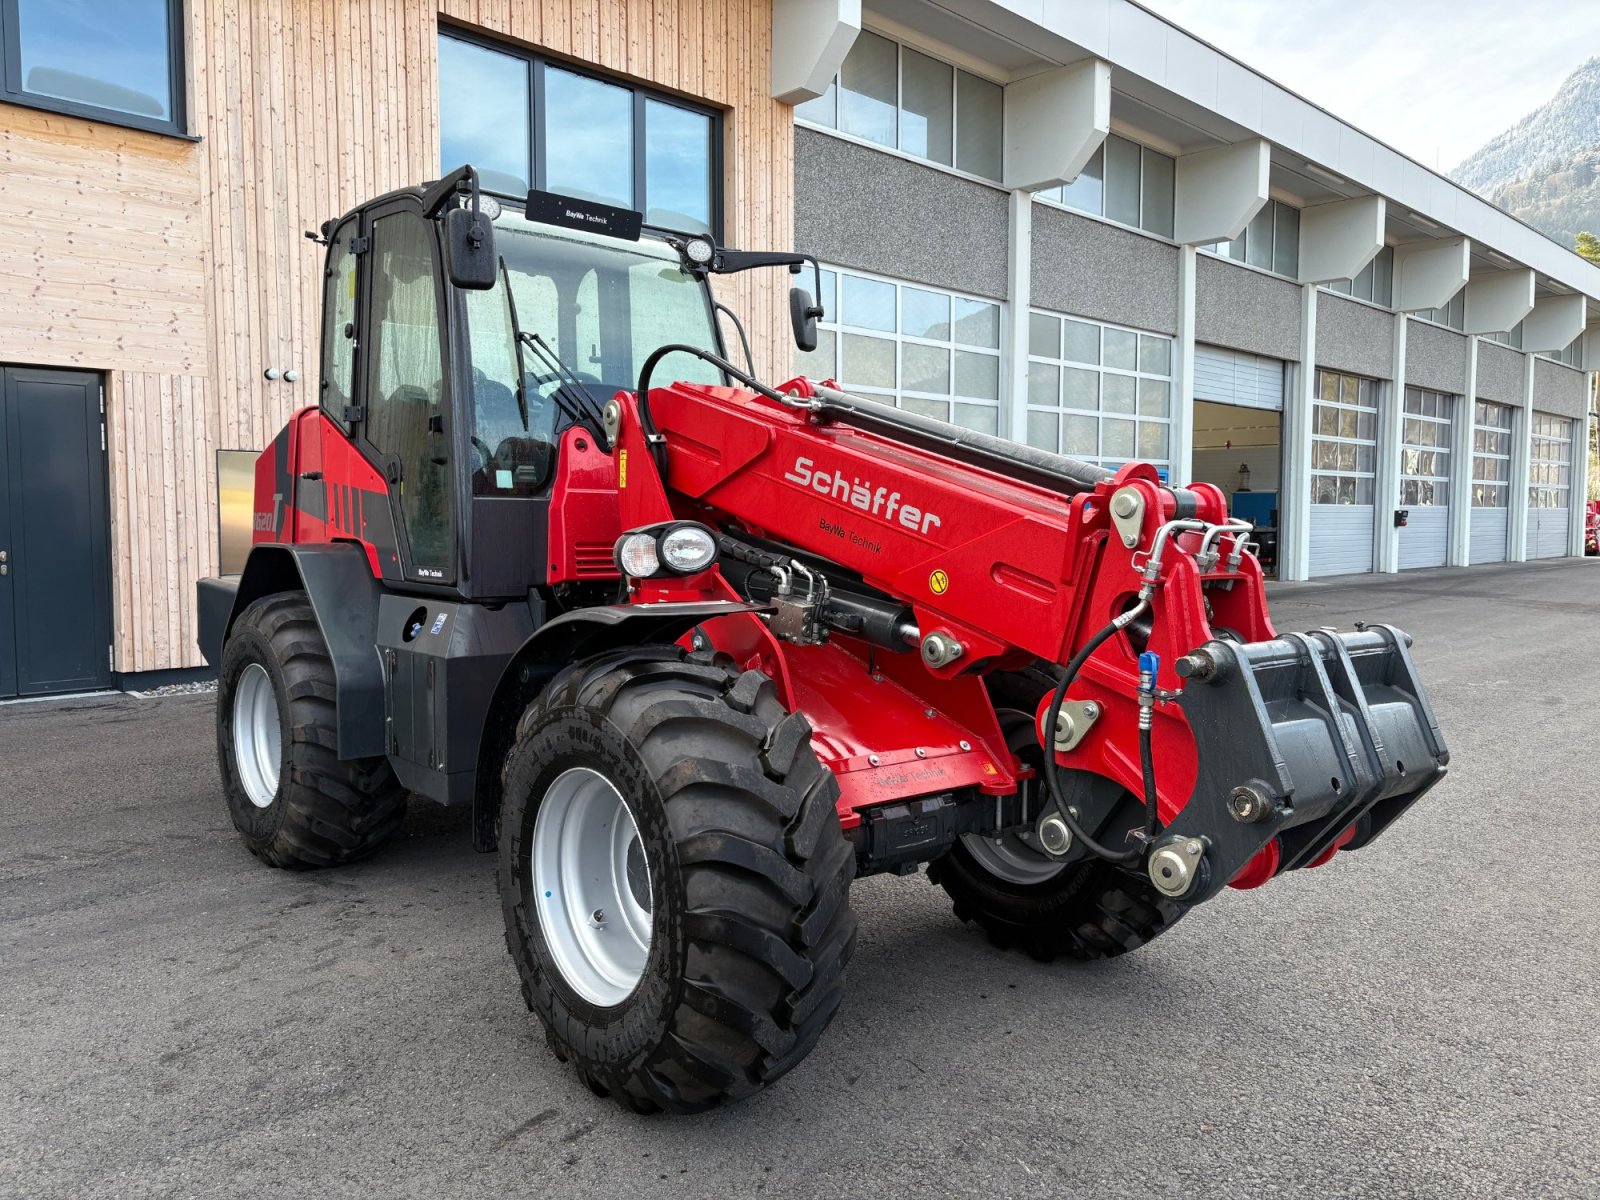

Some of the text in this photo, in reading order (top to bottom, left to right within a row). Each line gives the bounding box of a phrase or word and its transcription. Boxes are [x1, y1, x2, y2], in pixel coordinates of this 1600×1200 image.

[566, 209, 608, 225] BayWa Technik
[784, 456, 941, 535] Schäffer
[819, 518, 882, 554] BayWa Technik
[910, 767, 946, 784] Technik
